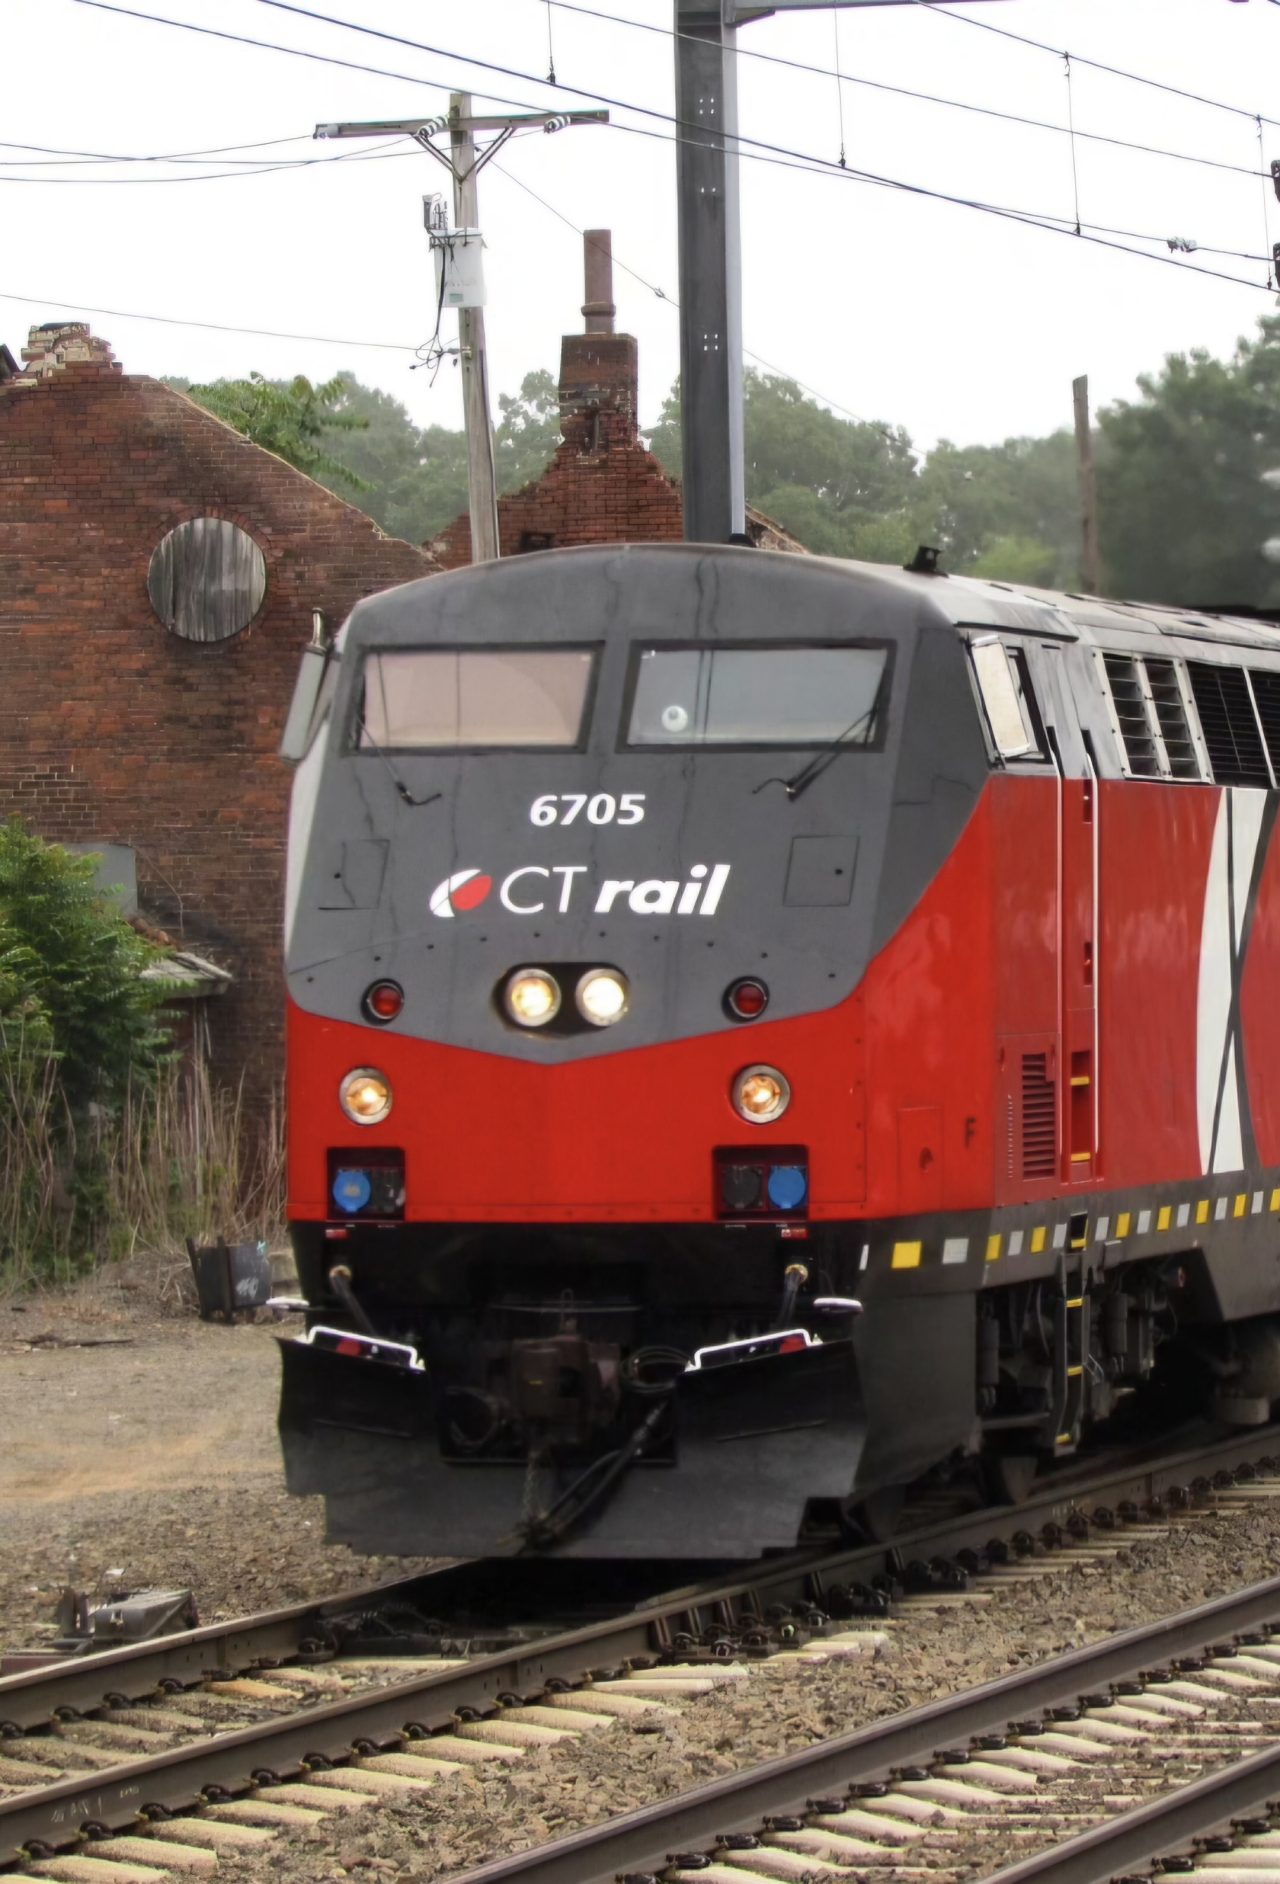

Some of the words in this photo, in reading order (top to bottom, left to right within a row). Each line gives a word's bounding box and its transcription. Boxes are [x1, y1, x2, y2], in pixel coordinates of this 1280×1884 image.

[529, 793, 646, 827] 6705
[500, 865, 588, 915] CT
[594, 863, 731, 916] rail
